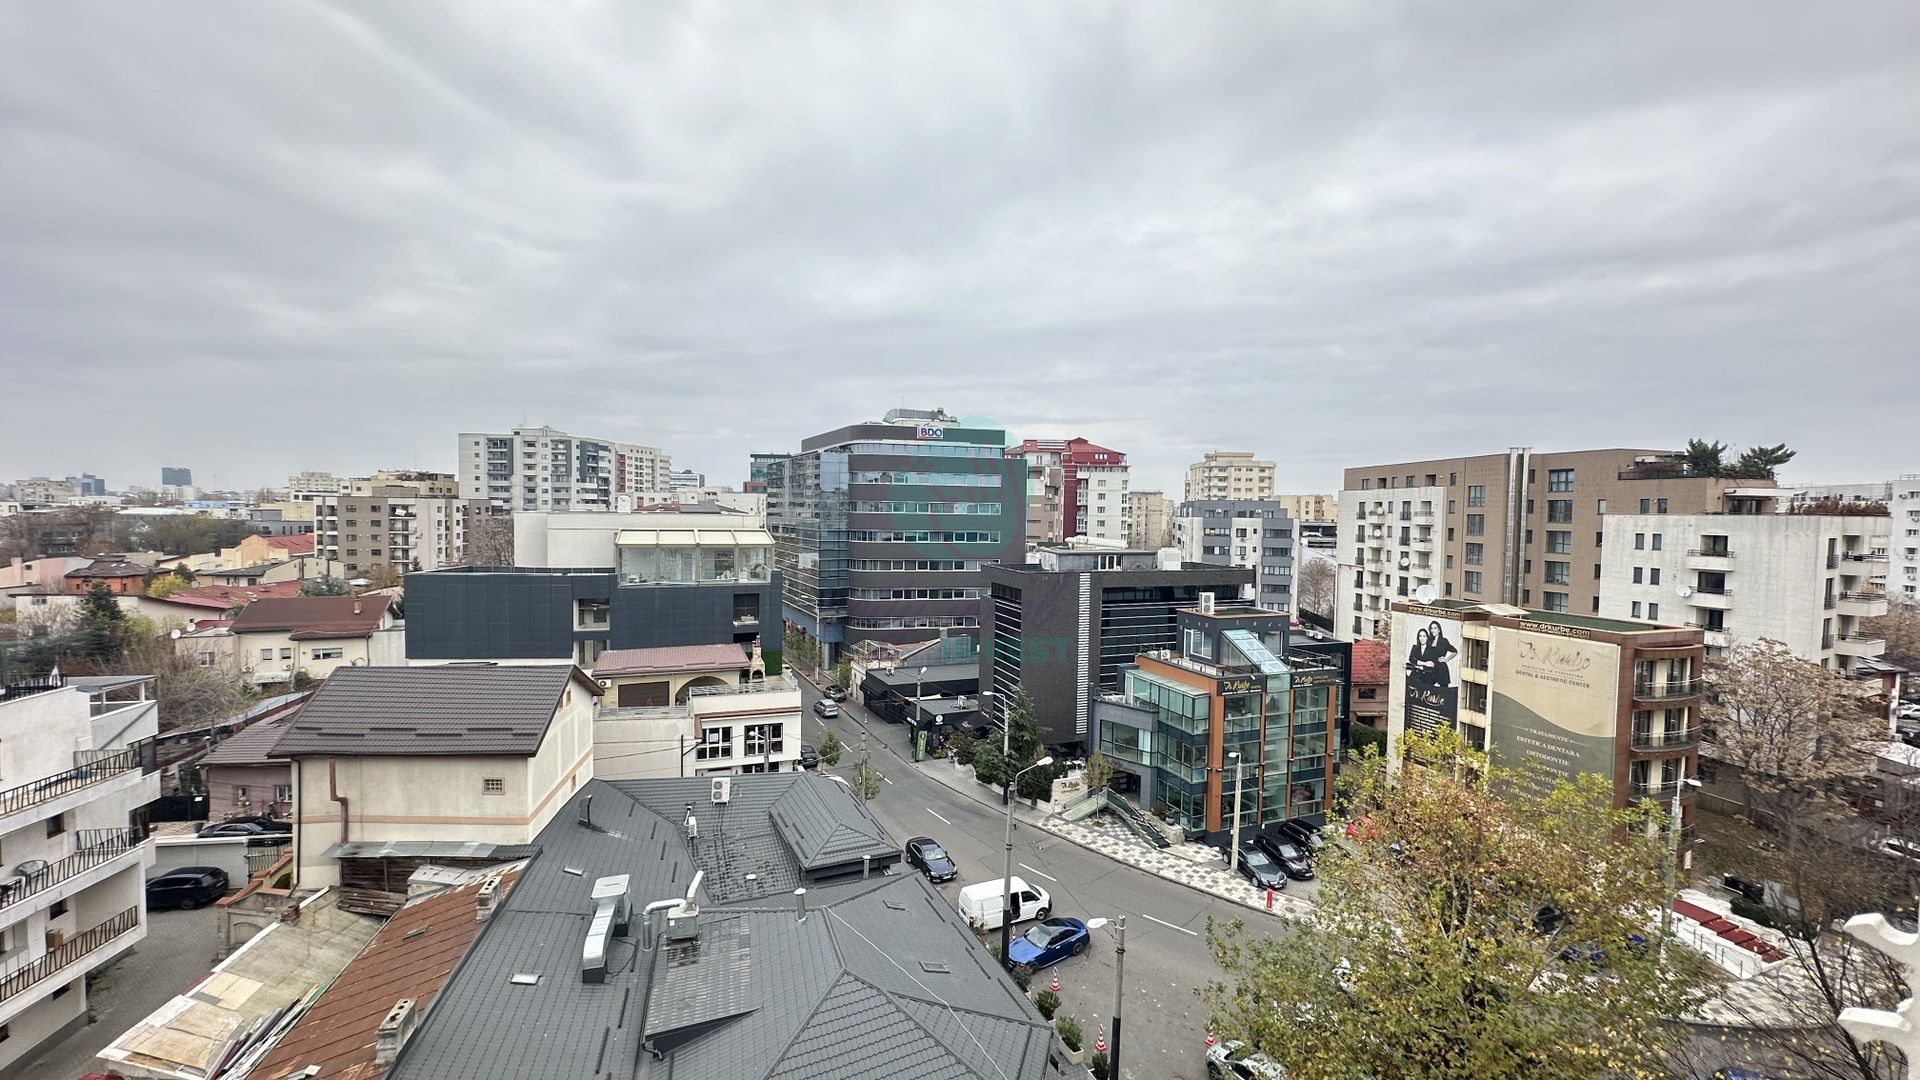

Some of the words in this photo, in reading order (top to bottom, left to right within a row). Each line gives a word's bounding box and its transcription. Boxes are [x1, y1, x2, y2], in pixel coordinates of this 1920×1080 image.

[921, 428, 943, 436] BDO
[1519, 621, 1591, 636] www.drkurbe.com
[1515, 669, 1534, 679] DENTAL
[1540, 674, 1568, 685] AESTHETIC
[1569, 679, 1591, 688] CENTER
[1530, 728, 1568, 743] TRATAMENTE
[1516, 735, 1547, 750] ESTETICA
[1548, 743, 1580, 758] DENTARA
[1526, 749, 1570, 766] ORTODONTIE
